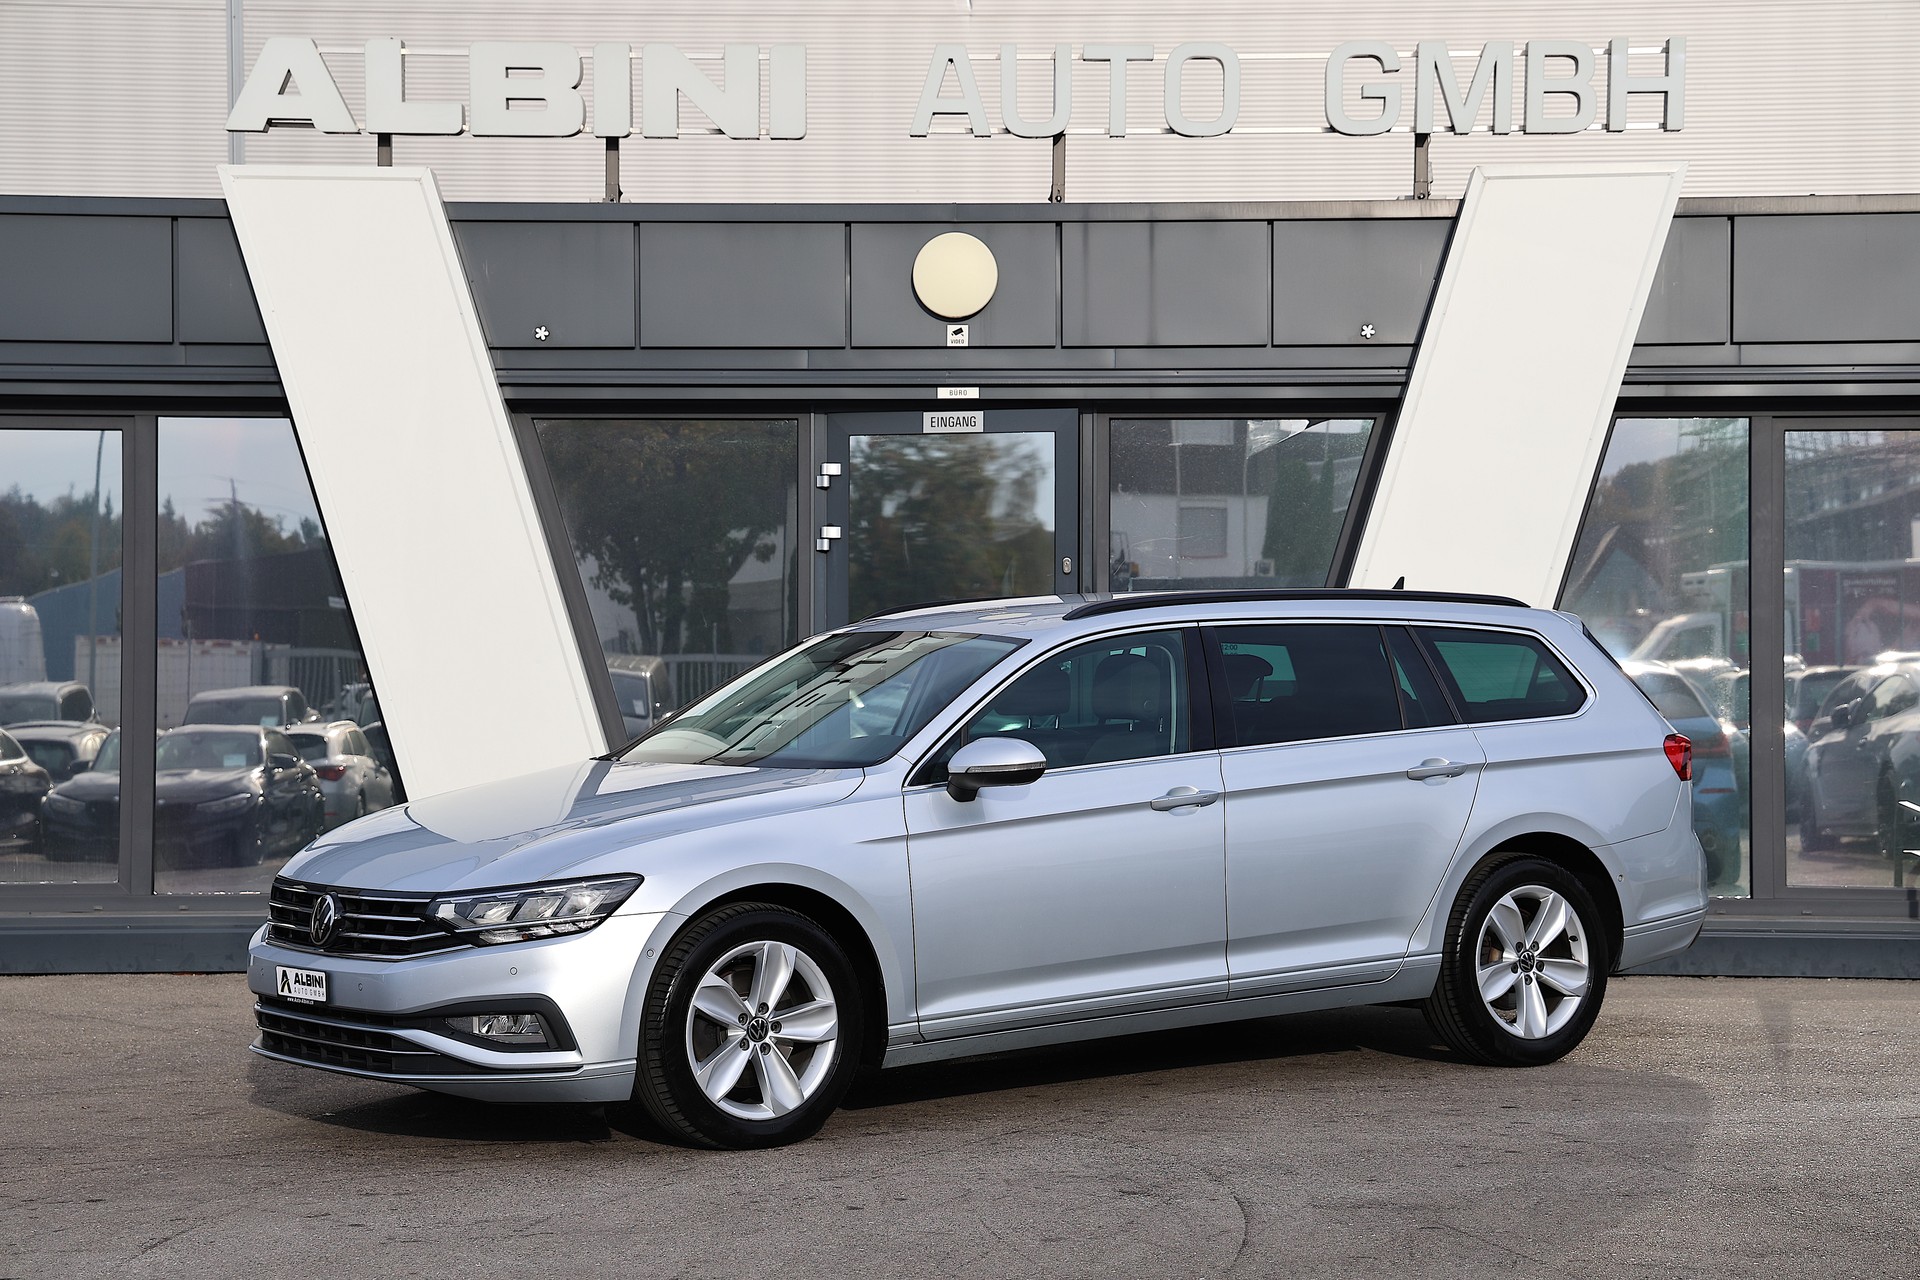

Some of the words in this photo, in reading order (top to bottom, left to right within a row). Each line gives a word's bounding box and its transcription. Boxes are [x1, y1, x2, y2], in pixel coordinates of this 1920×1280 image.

[226, 37, 807, 140] ALBINI
[909, 43, 1241, 138] AUTO
[1324, 37, 1686, 136] GMBH
[949, 388, 968, 396] BÜRO
[930, 415, 977, 428] EINGANG
[294, 972, 324, 988] ALBINI
[294, 986, 308, 996] AUTO
